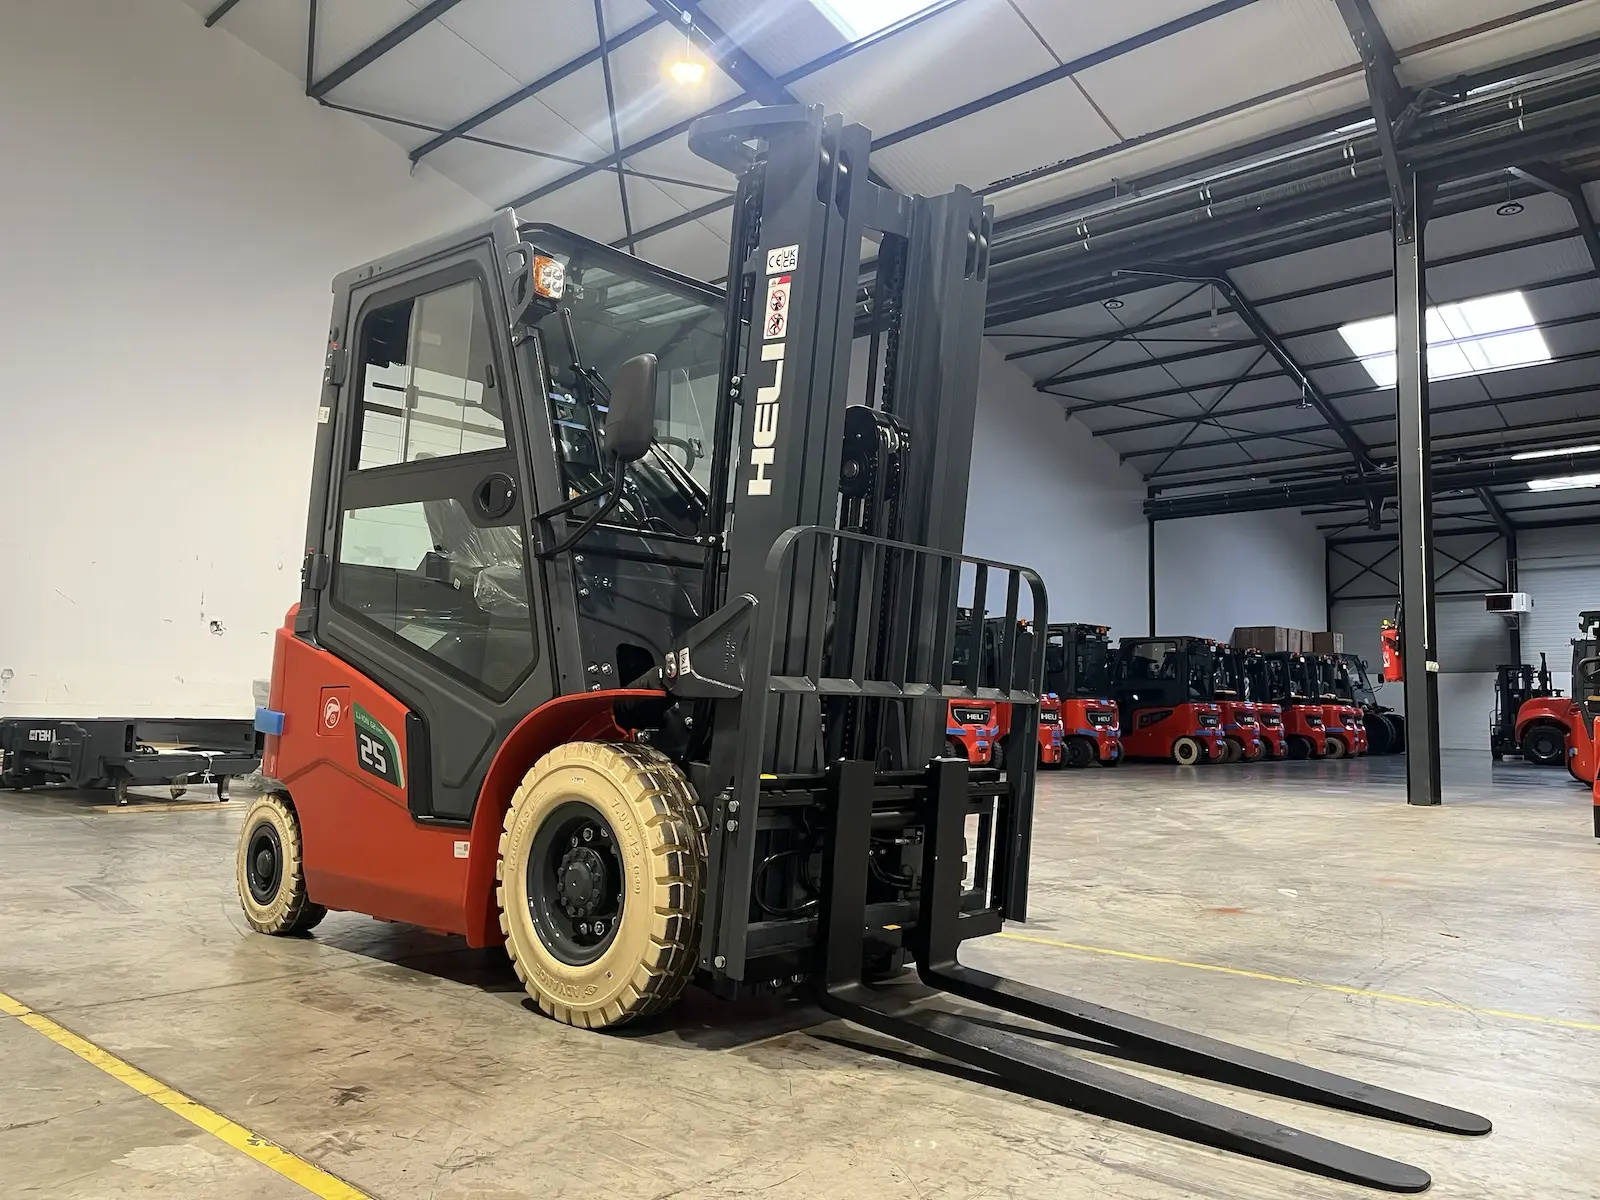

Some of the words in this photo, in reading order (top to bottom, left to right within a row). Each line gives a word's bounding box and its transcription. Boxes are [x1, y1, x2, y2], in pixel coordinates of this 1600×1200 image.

[783, 249, 797, 259] UK
[768, 254, 782, 268] CE
[783, 259, 796, 268] CA
[747, 342, 786, 496] HELI
[966, 713, 984, 721] HELI
[1040, 712, 1057, 721] HELI
[360, 733, 387, 774] 25
